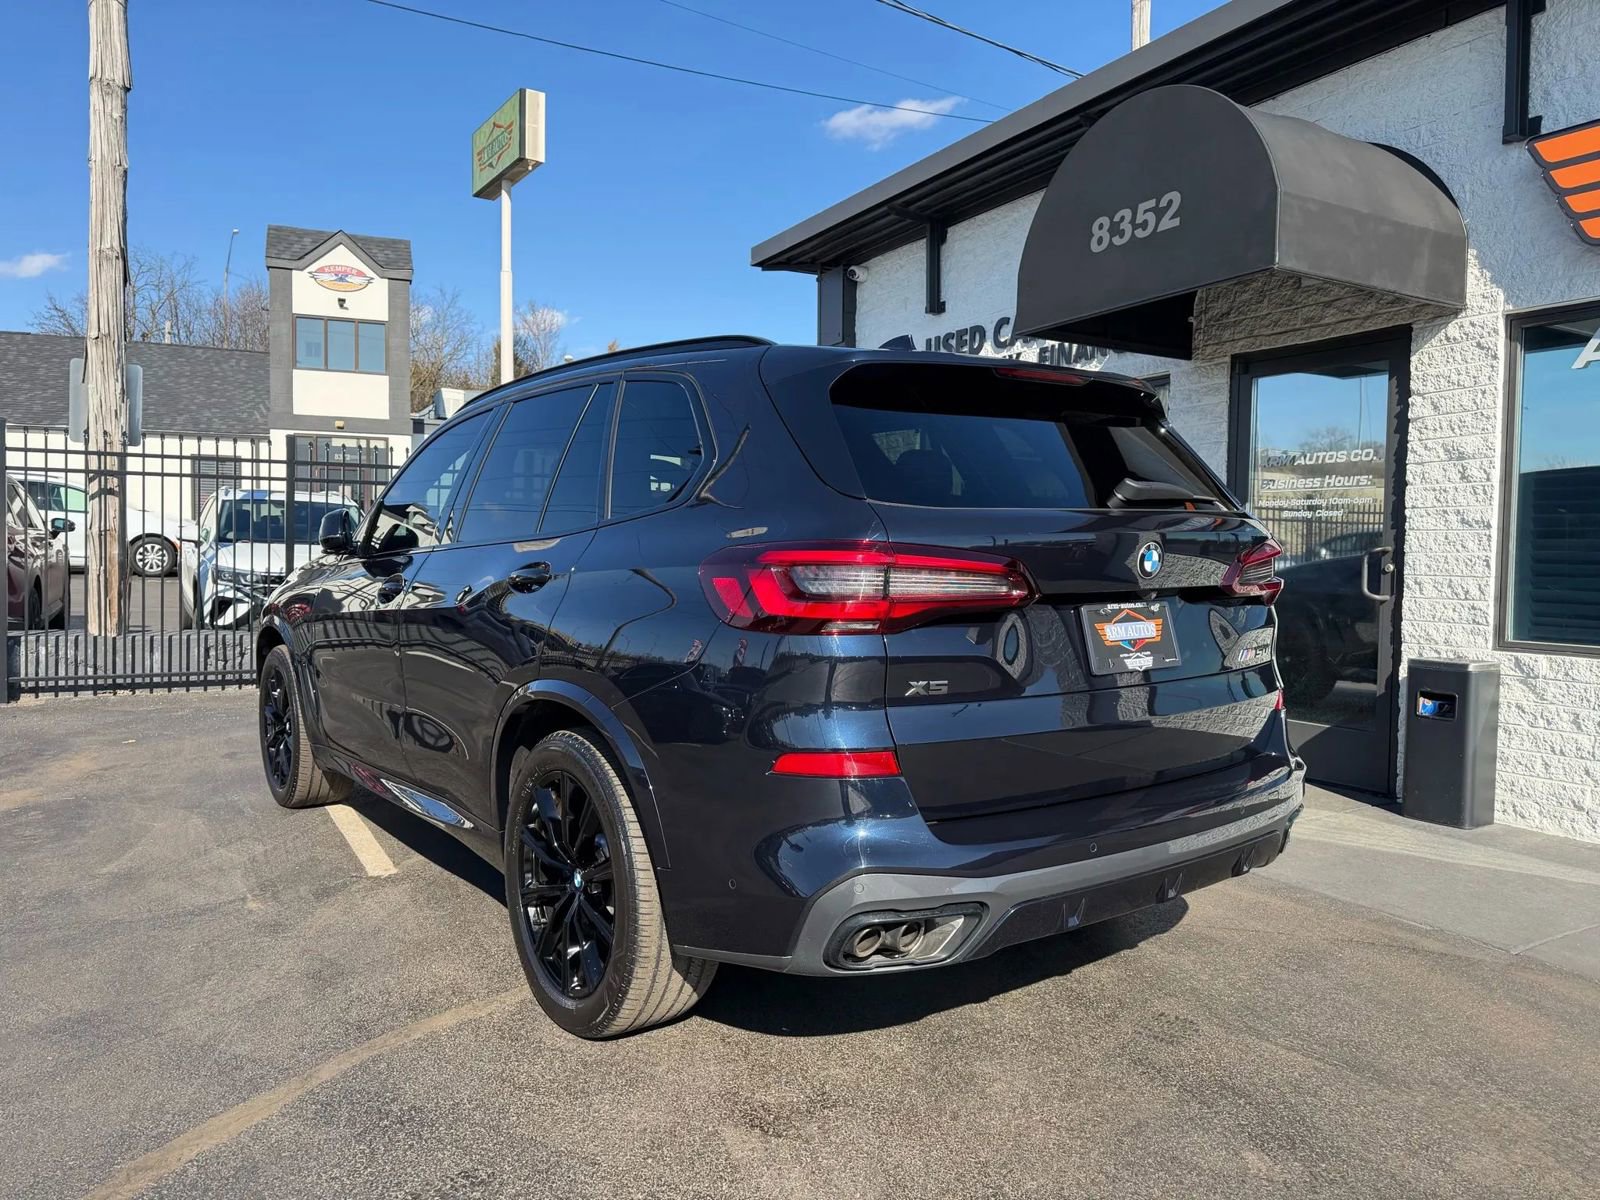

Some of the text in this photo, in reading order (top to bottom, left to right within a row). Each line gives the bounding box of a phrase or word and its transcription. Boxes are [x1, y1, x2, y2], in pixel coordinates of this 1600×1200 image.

[1090, 190, 1181, 253] 8352
[925, 324, 986, 355] USED
[1294, 451, 1350, 466] AUTOS
[1350, 449, 1377, 462] CO.
[1262, 475, 1373, 490] Business Hours:
[1258, 496, 1373, 508] Monday-Saturday 10am-6pm
[1282, 508, 1344, 518] Sunday Closed
[1106, 623, 1156, 639] ARM AUTOS
[904, 680, 949, 696] X5
